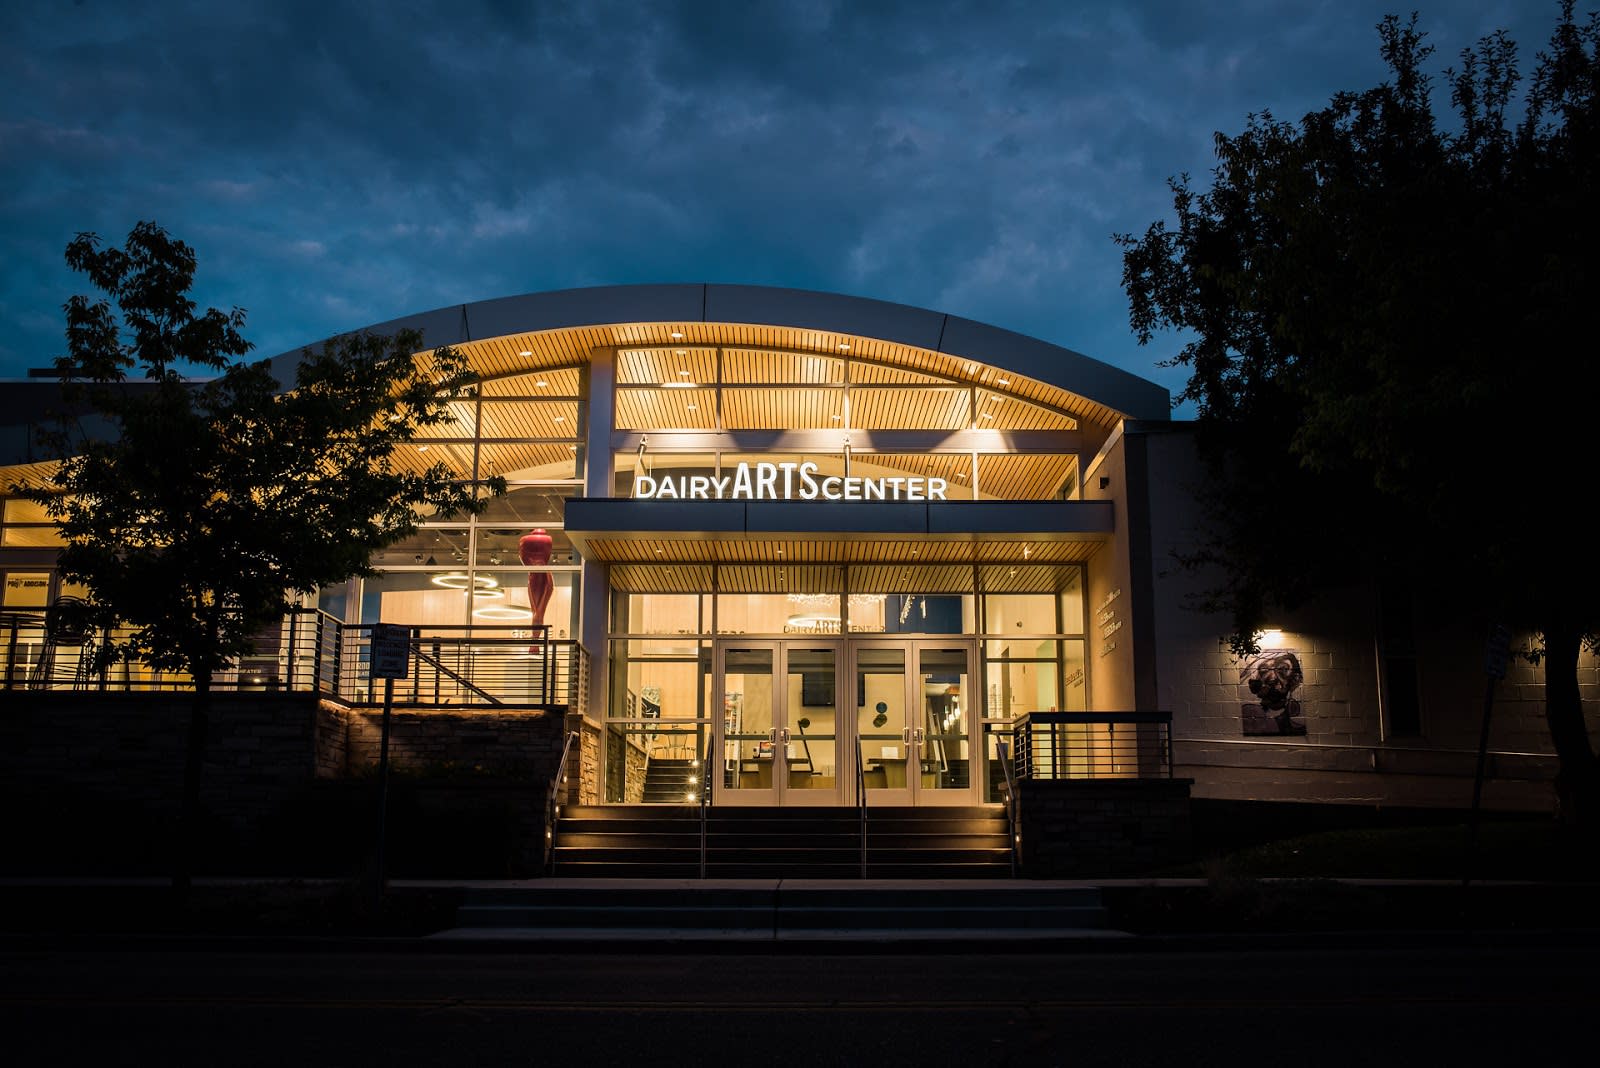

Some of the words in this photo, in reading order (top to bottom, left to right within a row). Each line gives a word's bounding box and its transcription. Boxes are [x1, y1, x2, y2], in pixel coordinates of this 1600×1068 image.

[635, 475, 731, 499] DAIRY
[732, 462, 819, 500] ARTS
[821, 477, 948, 500] CENTER
[783, 625, 814, 634] DAIRY
[814, 620, 842, 634] ARTS
